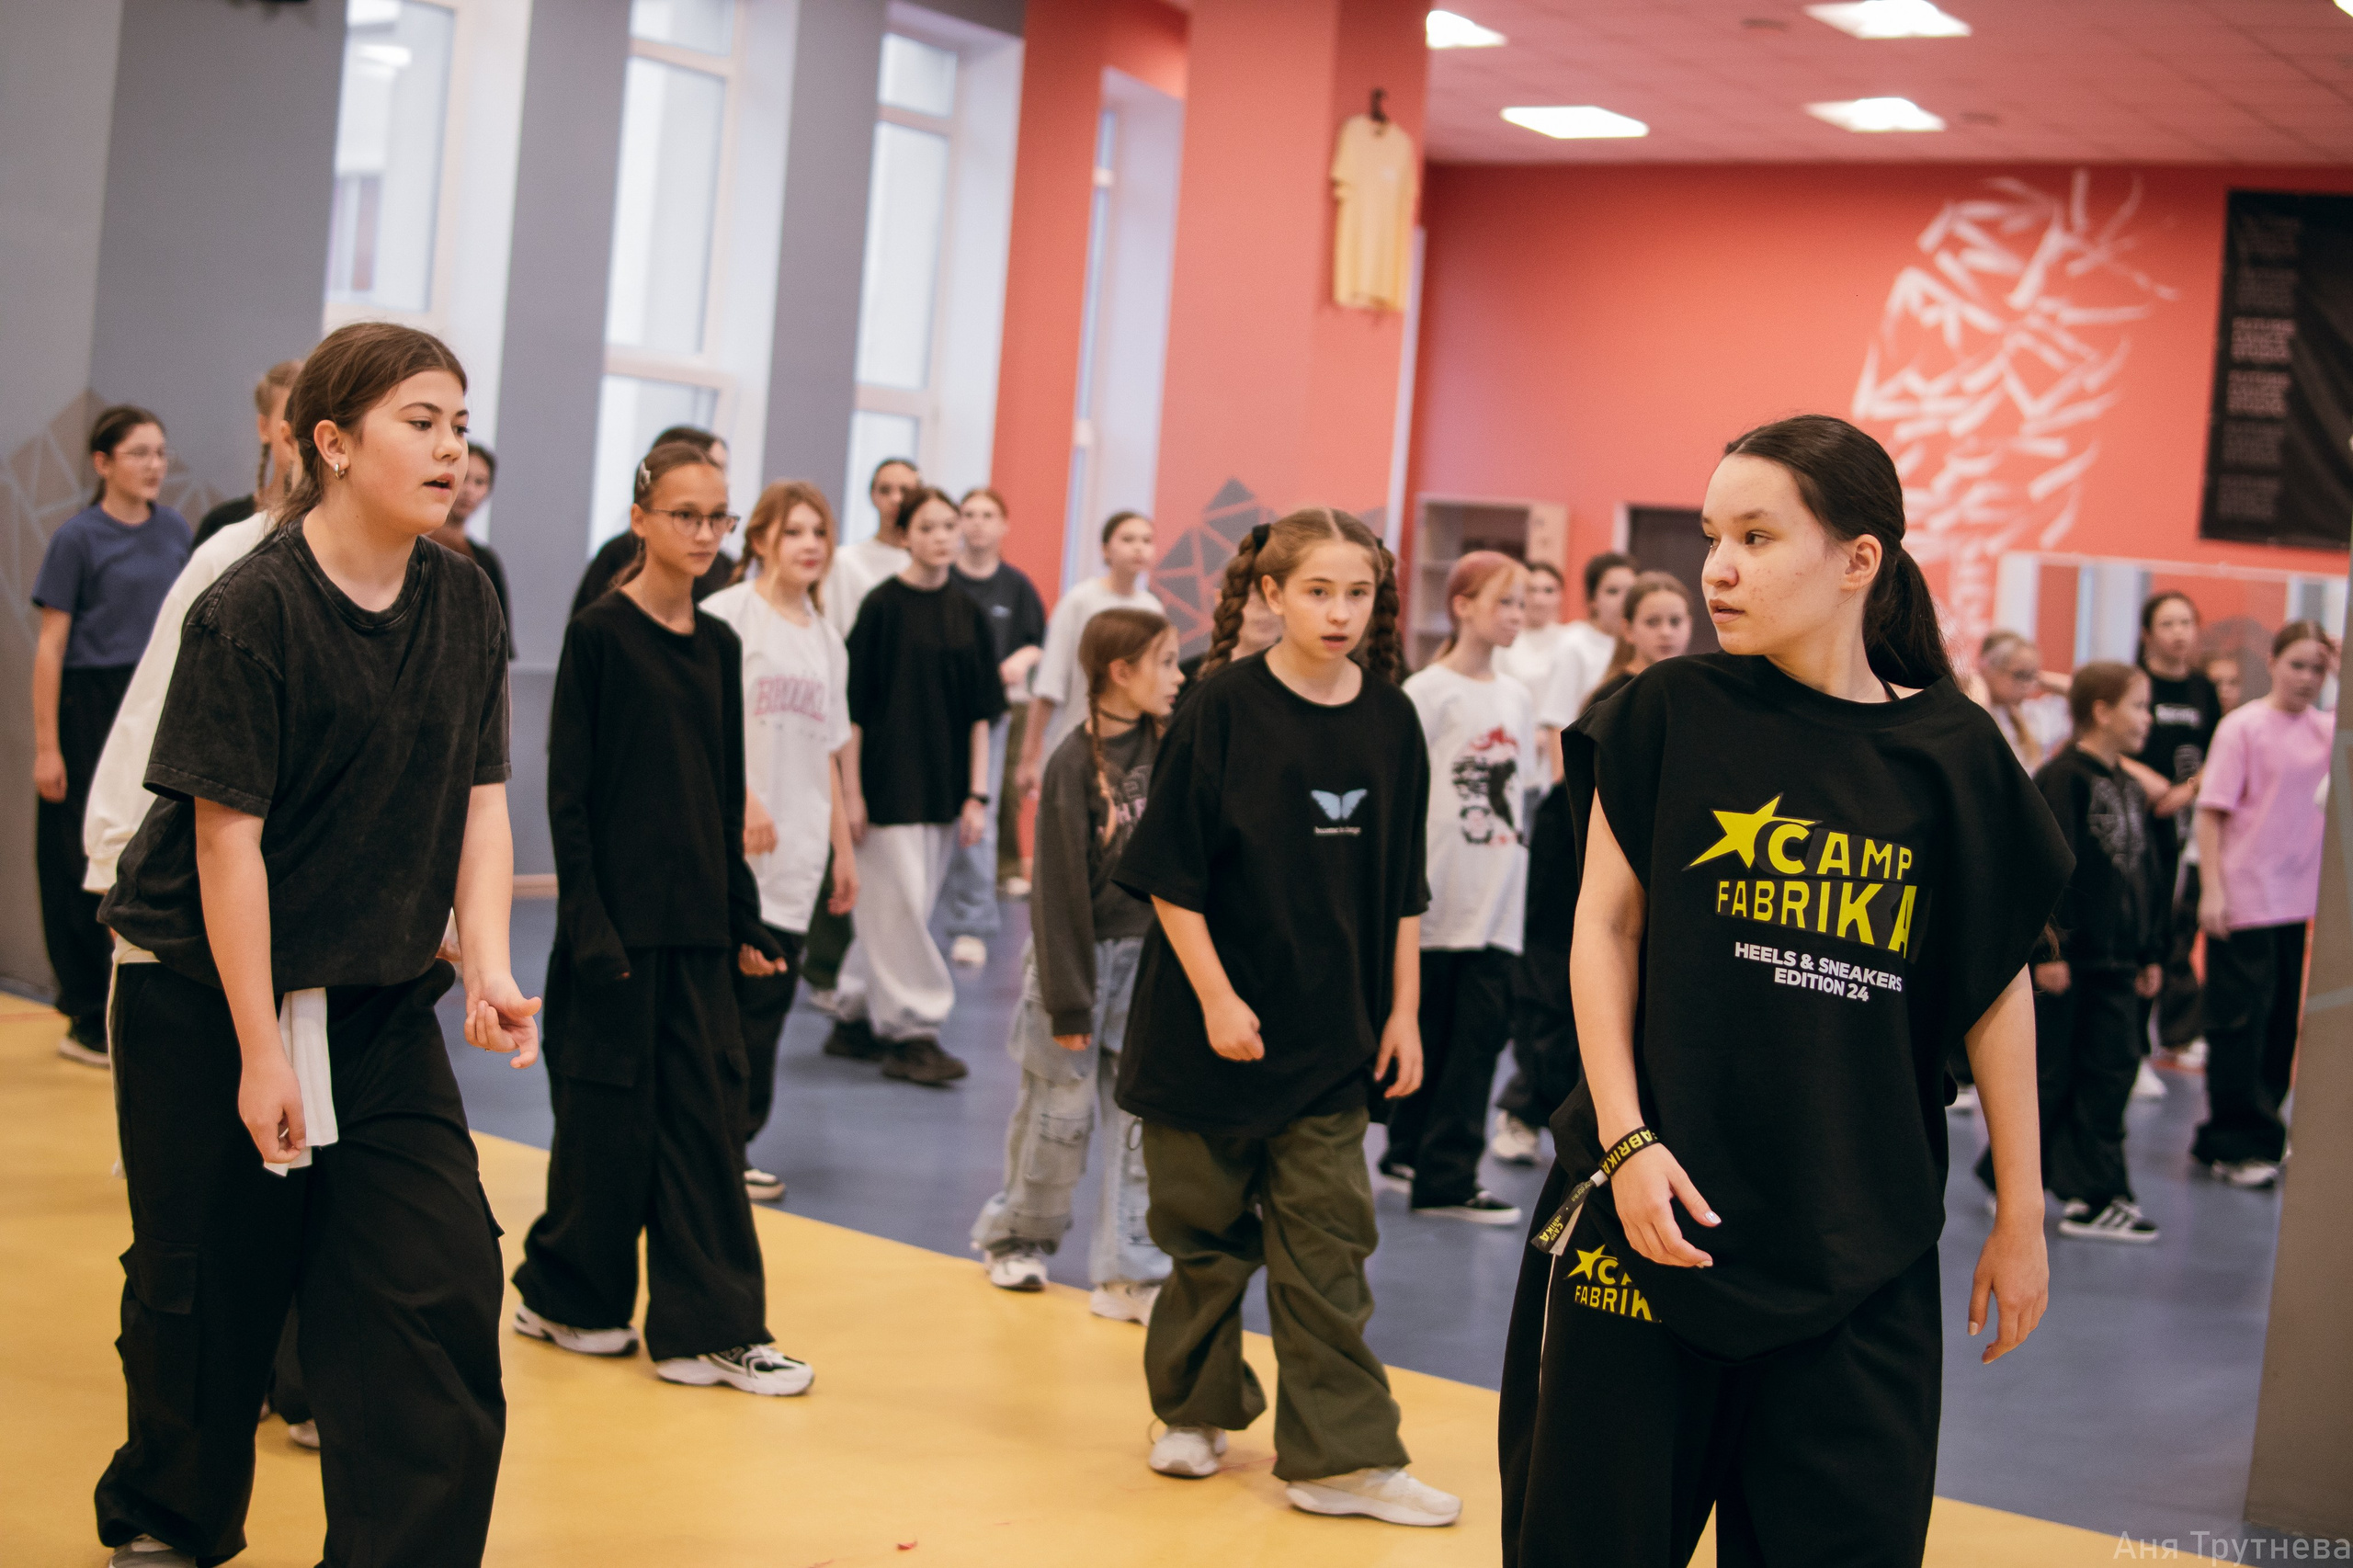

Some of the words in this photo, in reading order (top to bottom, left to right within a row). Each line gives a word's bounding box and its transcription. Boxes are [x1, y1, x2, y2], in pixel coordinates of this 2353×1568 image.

[1768, 824, 1913, 880] CAMP
[1717, 881, 1917, 959] FABRIKA
[1734, 942, 1797, 967] HEELS
[1800, 953, 1814, 971] &
[1818, 958, 1903, 993] SNEAKERS
[1774, 968, 1845, 996] EDITION
[1847, 983, 1870, 1002] 24
[1574, 1285, 1662, 1323] FABRIK
